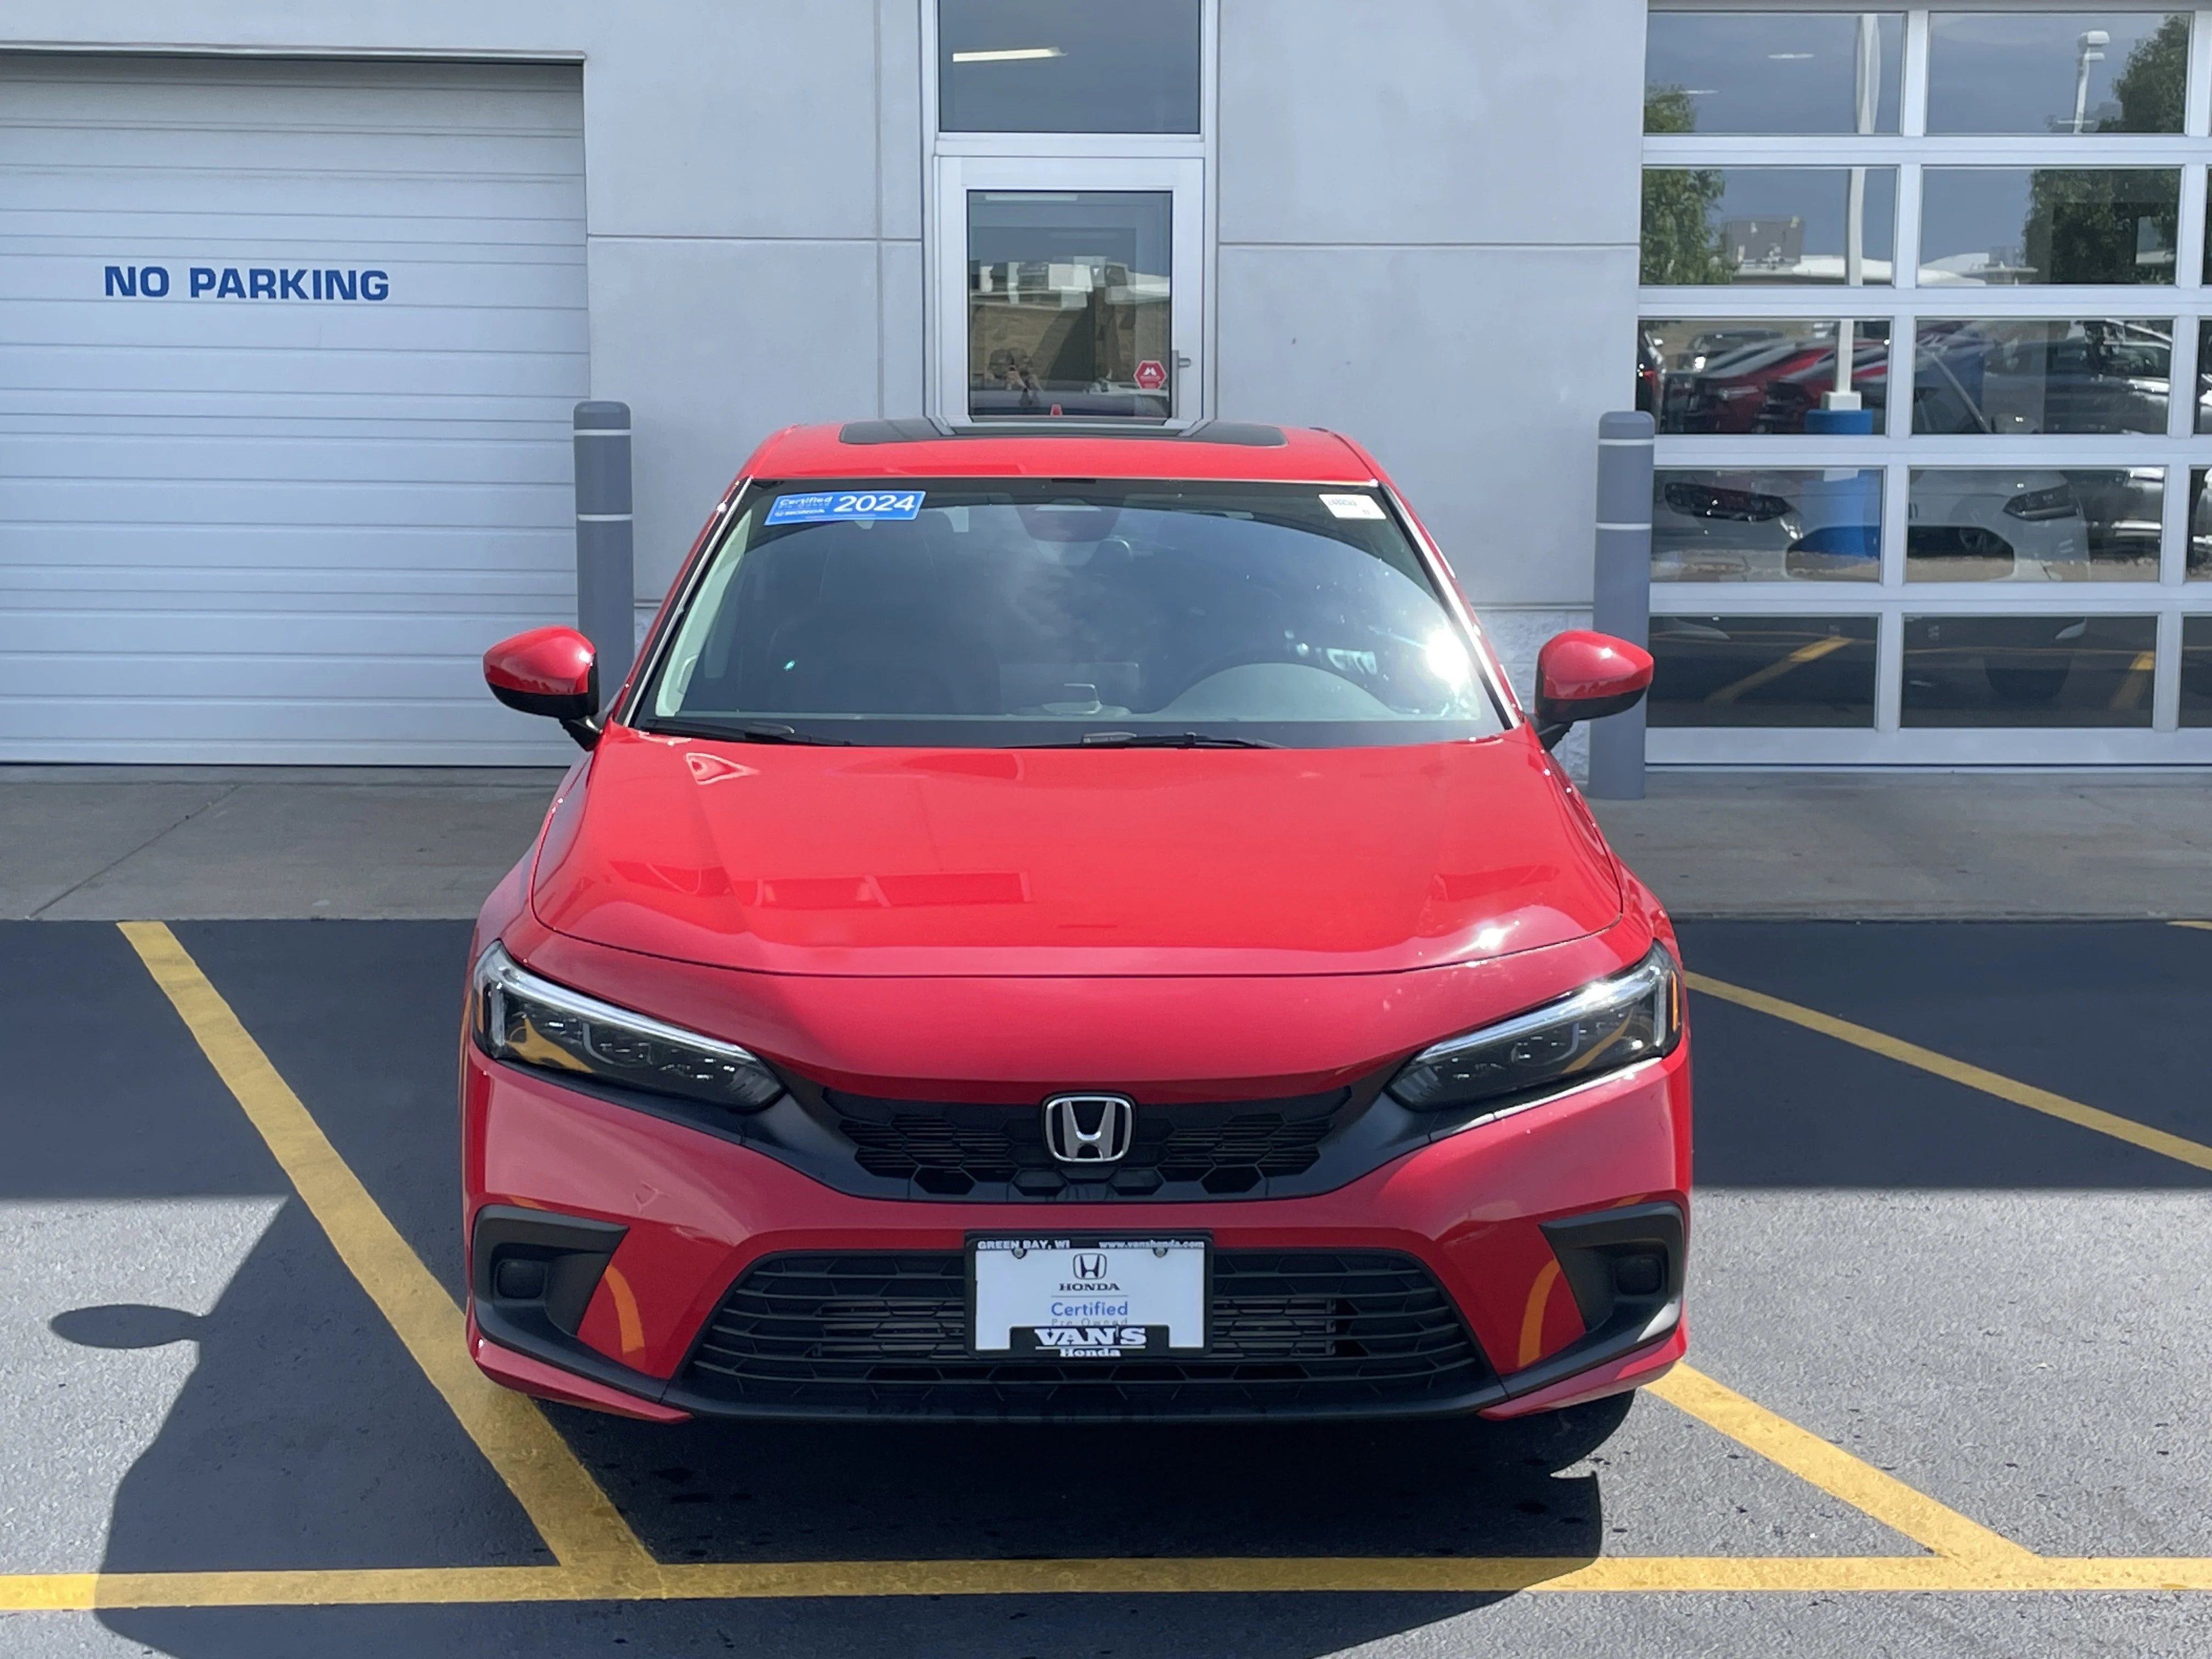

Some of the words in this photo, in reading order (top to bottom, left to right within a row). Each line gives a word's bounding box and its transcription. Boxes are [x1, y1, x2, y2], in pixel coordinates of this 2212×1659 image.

[104, 266, 170, 297] NO
[190, 267, 389, 301] PARKING
[779, 495, 833, 505] Certified
[833, 495, 916, 512] 2024
[977, 1240, 1020, 1250] GREEN
[1022, 1239, 1052, 1250] BAY,
[1054, 1239, 1070, 1249] WI
[1098, 1239, 1204, 1248] www.vanshonda.com
[1059, 1283, 1121, 1291] HONDA
[1051, 1301, 1128, 1317] Certified
[1059, 1347, 1121, 1358] Honda
